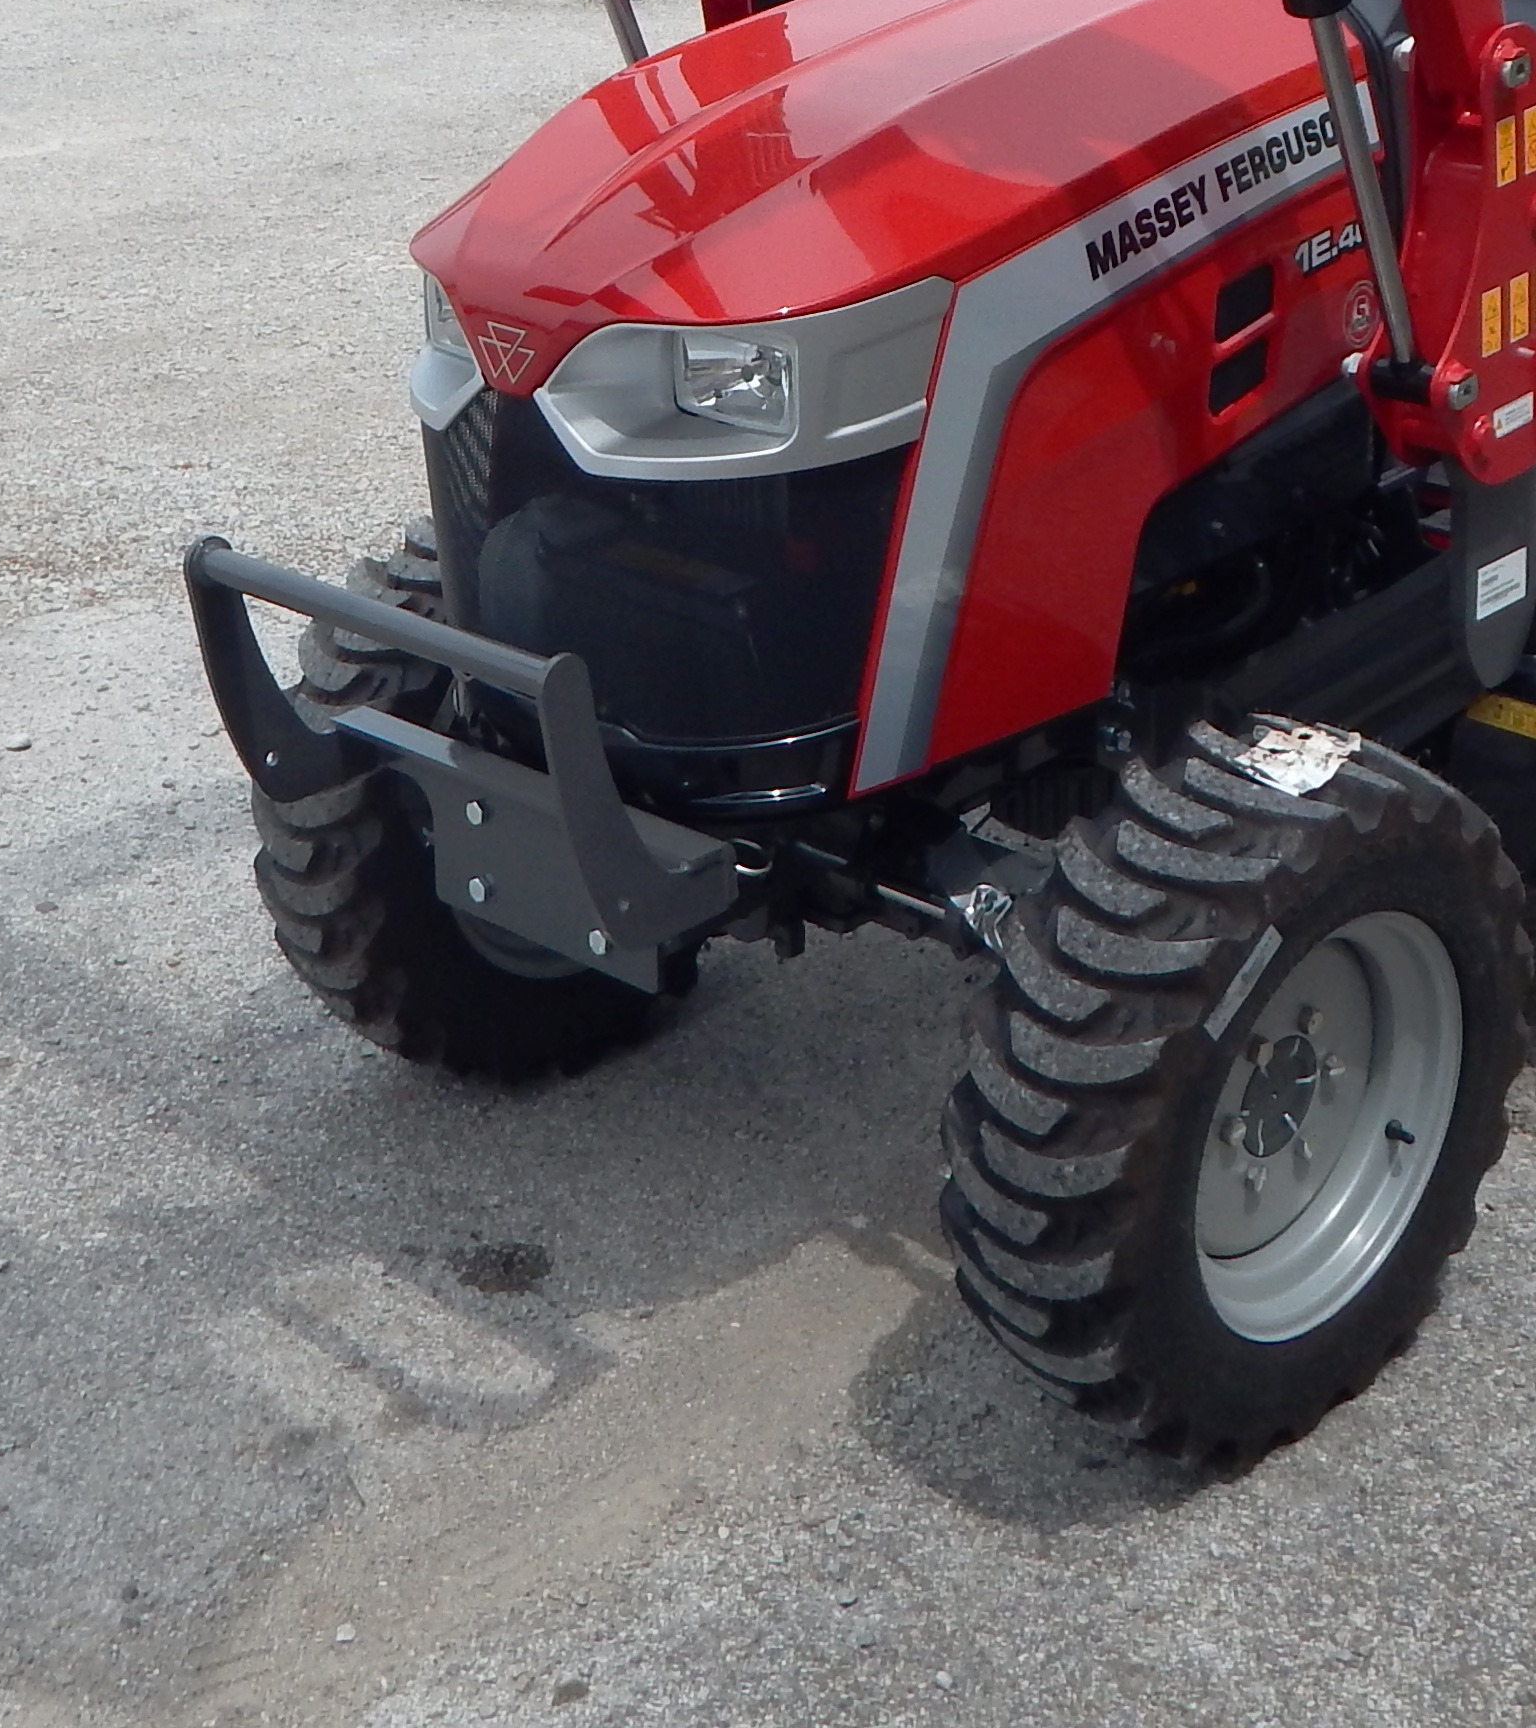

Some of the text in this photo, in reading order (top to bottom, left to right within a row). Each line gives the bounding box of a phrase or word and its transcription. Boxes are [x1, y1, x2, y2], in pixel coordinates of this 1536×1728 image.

[1085, 111, 1340, 281] MASSEY FERGUSO
[1293, 222, 1363, 275] 1E.4
